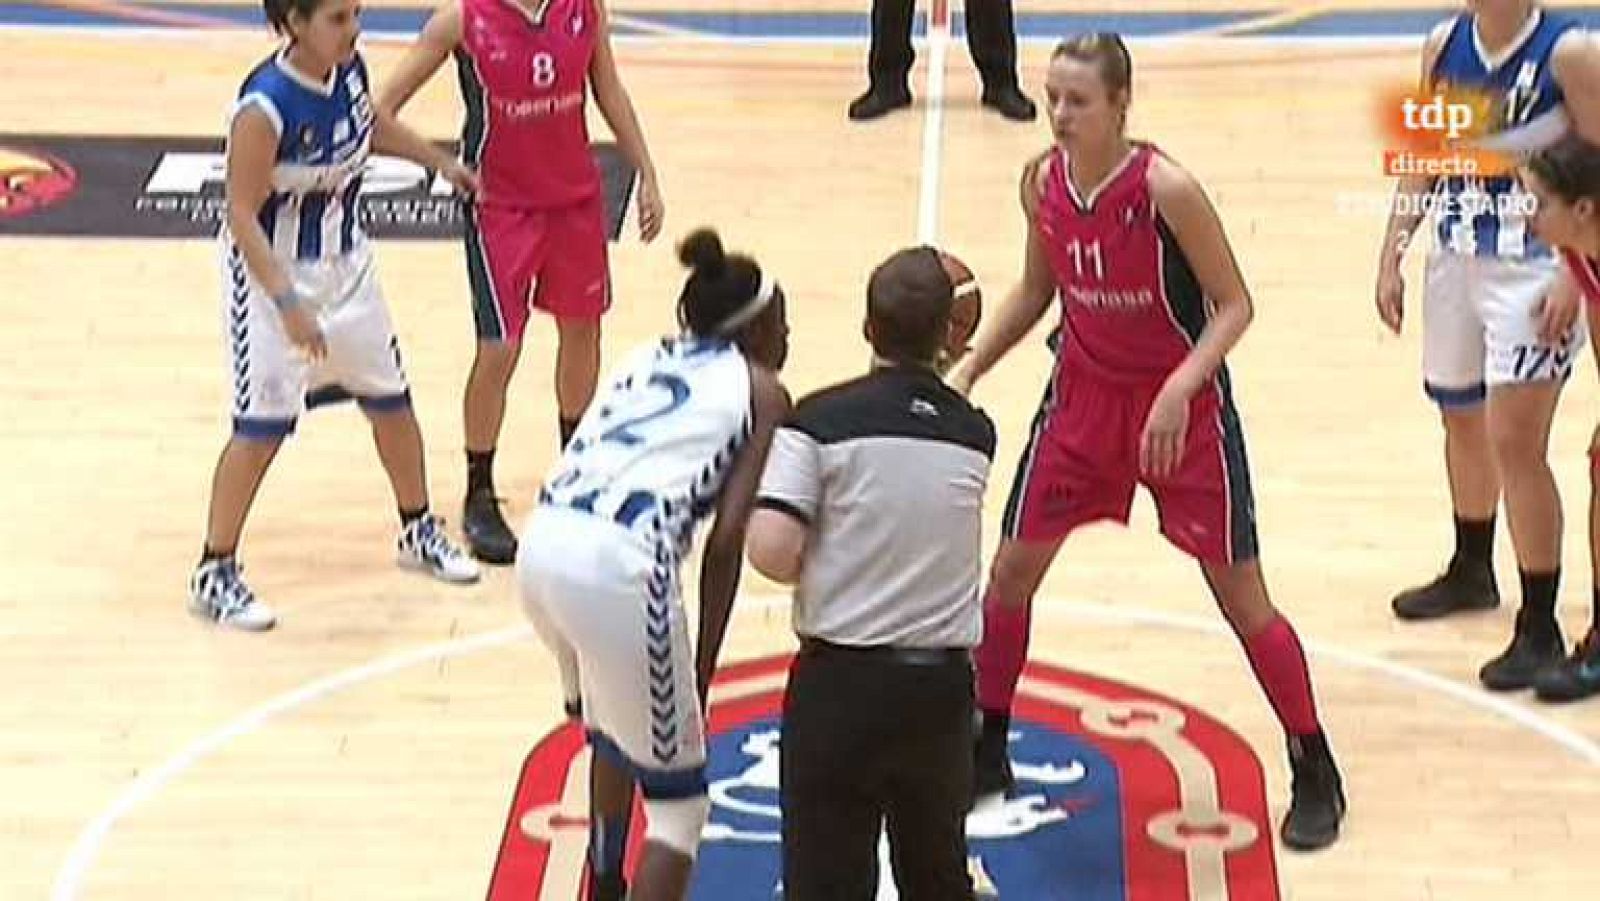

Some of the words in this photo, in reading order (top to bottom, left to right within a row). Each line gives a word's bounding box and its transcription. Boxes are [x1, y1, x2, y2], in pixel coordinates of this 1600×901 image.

[532, 52, 555, 88] 8
[1065, 236, 1104, 281] 11
[598, 371, 692, 448] 2
